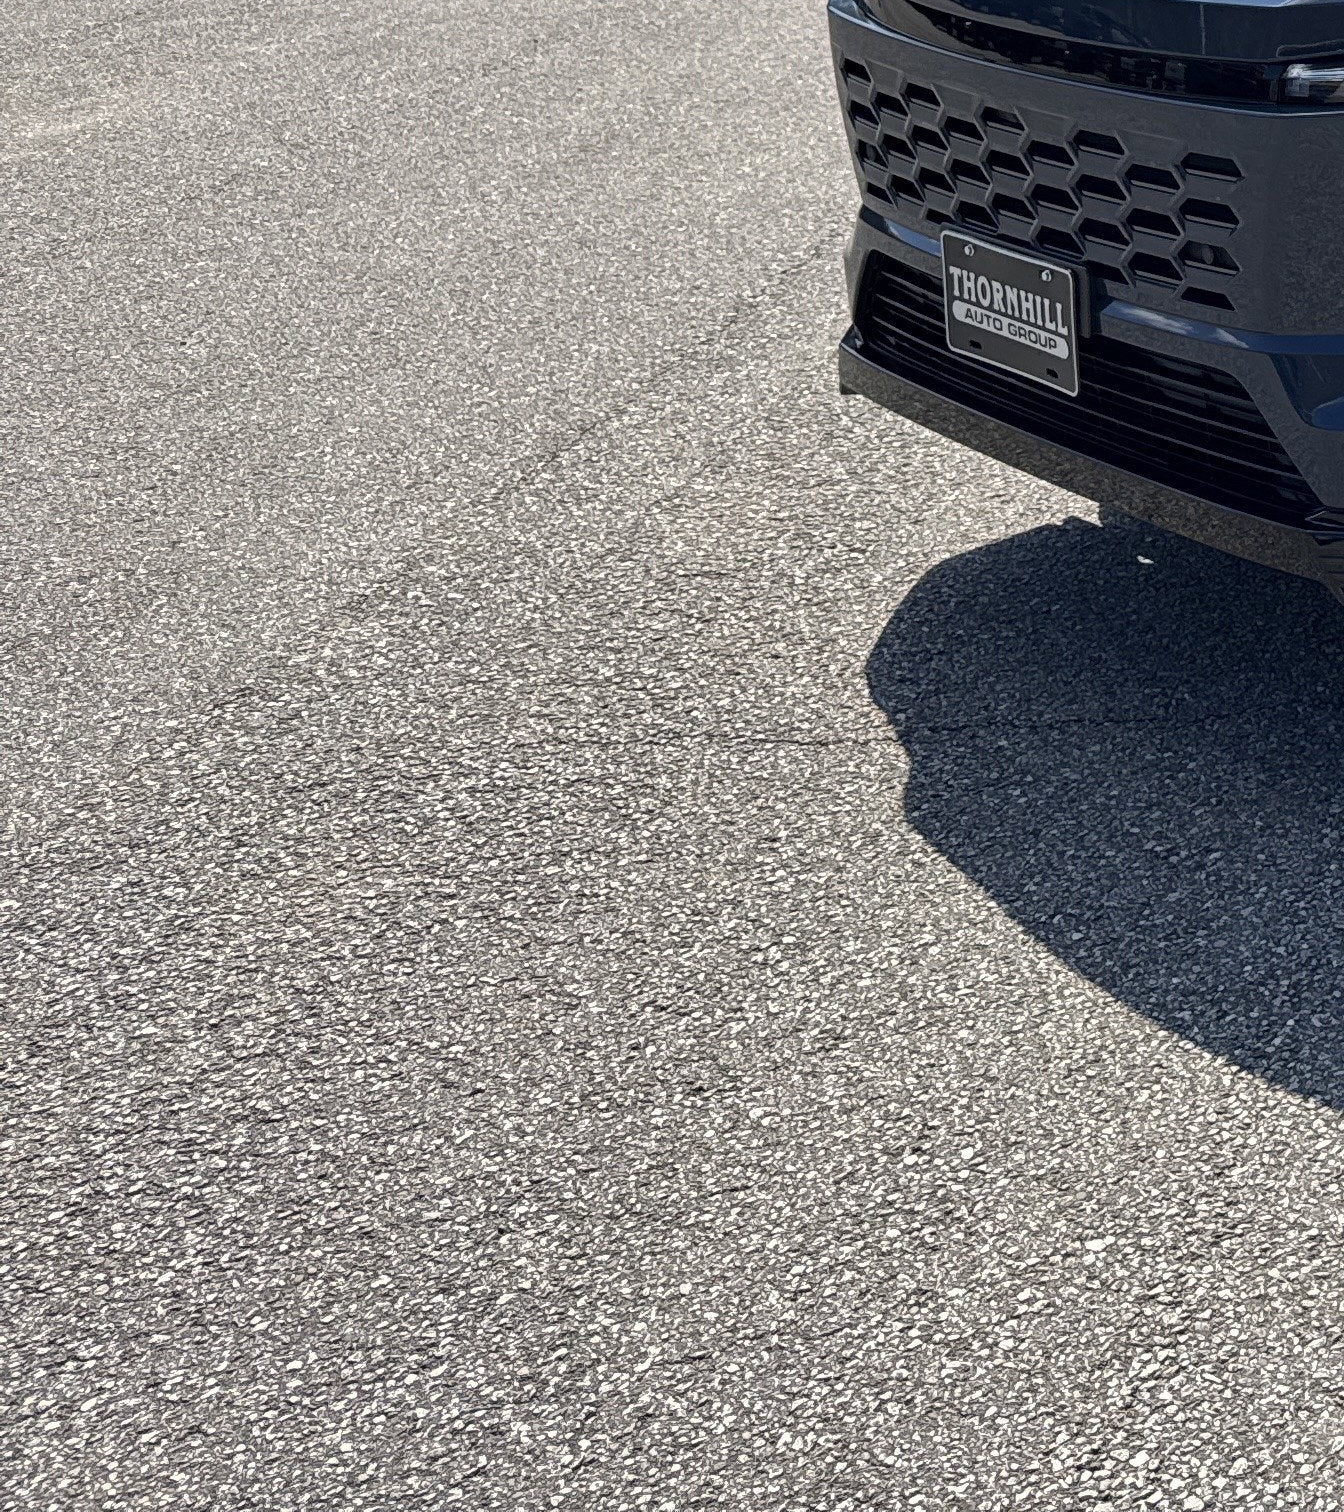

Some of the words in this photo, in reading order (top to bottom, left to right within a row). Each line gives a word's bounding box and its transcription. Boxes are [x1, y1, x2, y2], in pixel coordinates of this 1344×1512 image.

[948, 265, 1069, 336] THORNHILL
[964, 307, 1003, 332] AUTO
[1008, 323, 1058, 350] GROUP
